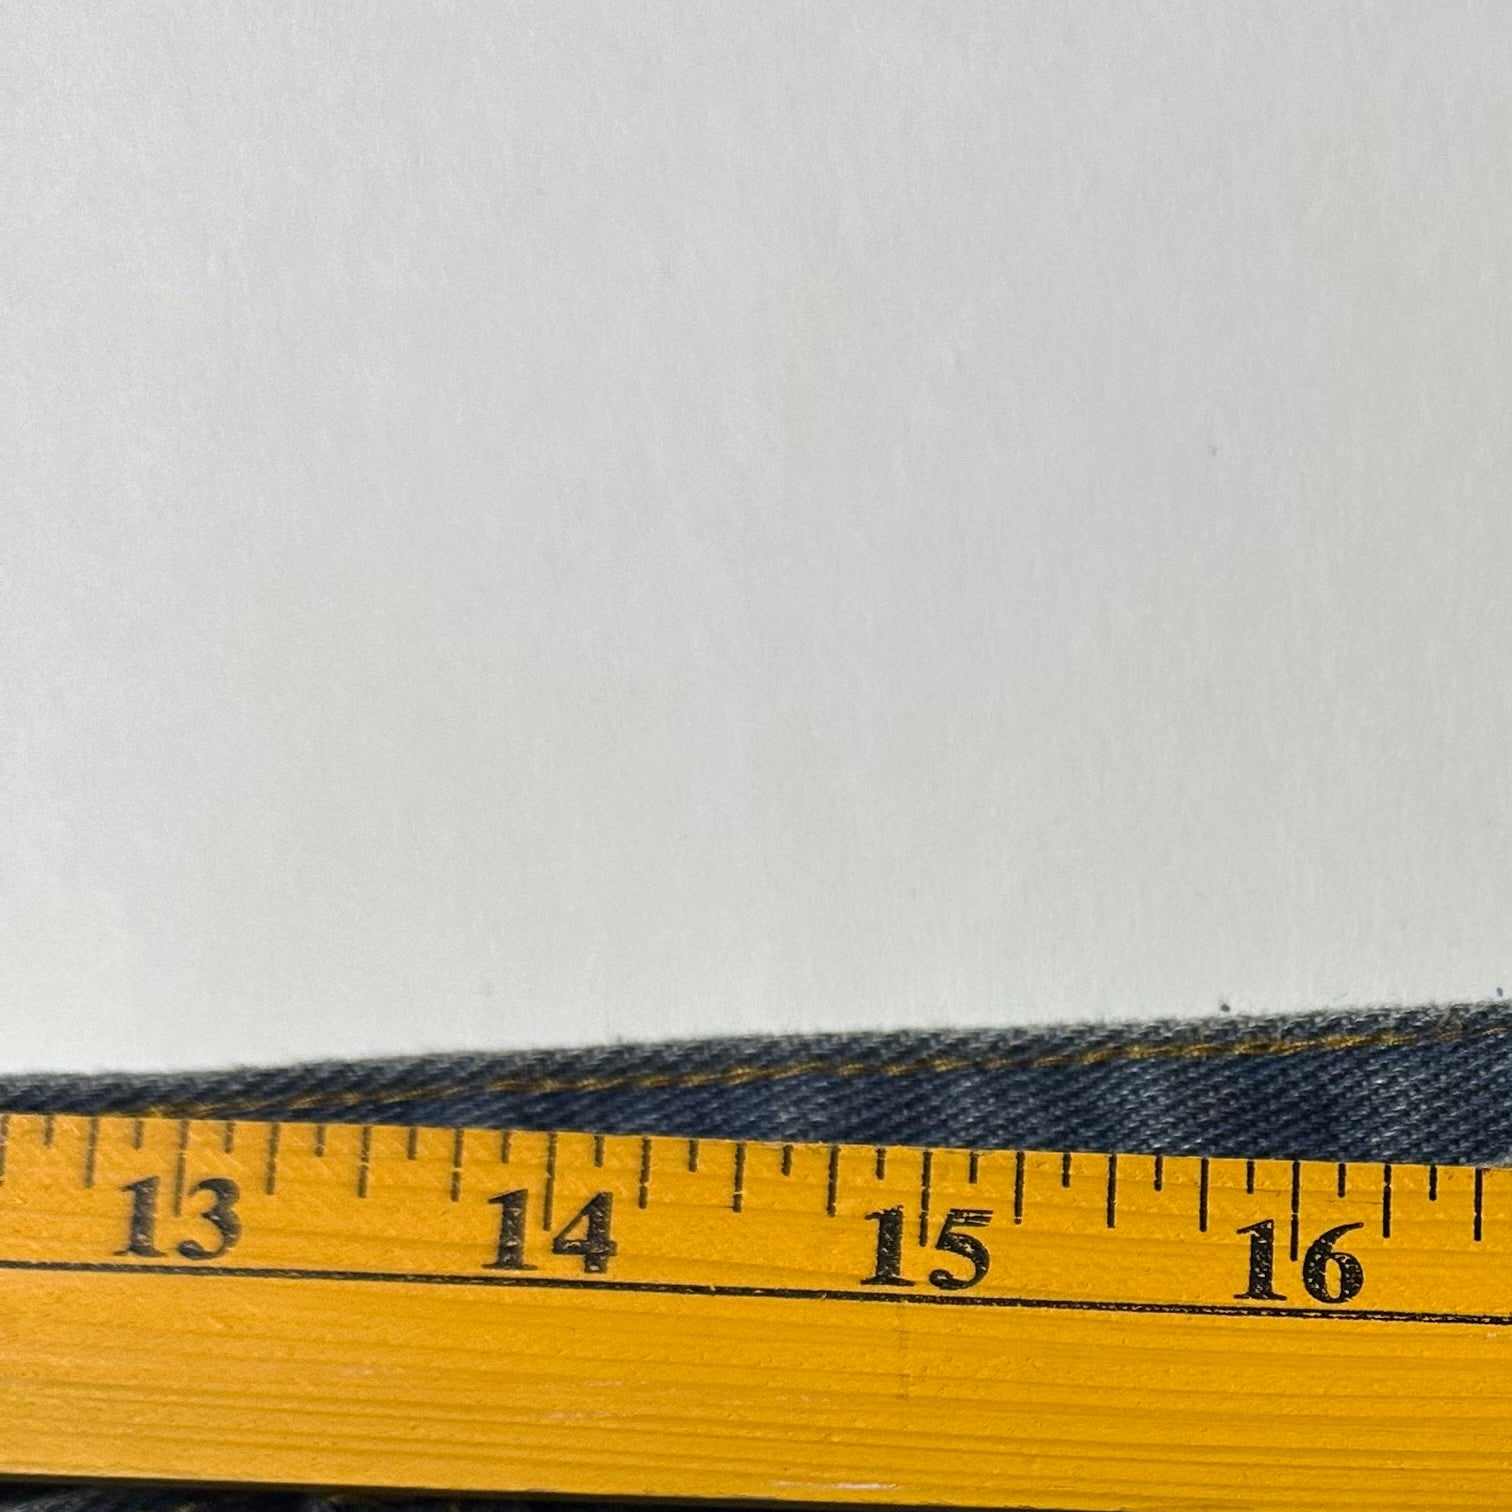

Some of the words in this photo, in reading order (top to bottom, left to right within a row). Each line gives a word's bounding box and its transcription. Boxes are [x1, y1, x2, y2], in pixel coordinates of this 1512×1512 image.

[114, 1178, 240, 1260] 13
[482, 1189, 617, 1273] 14
[860, 1205, 993, 1290] 15
[1234, 1219, 1364, 1303] 16
